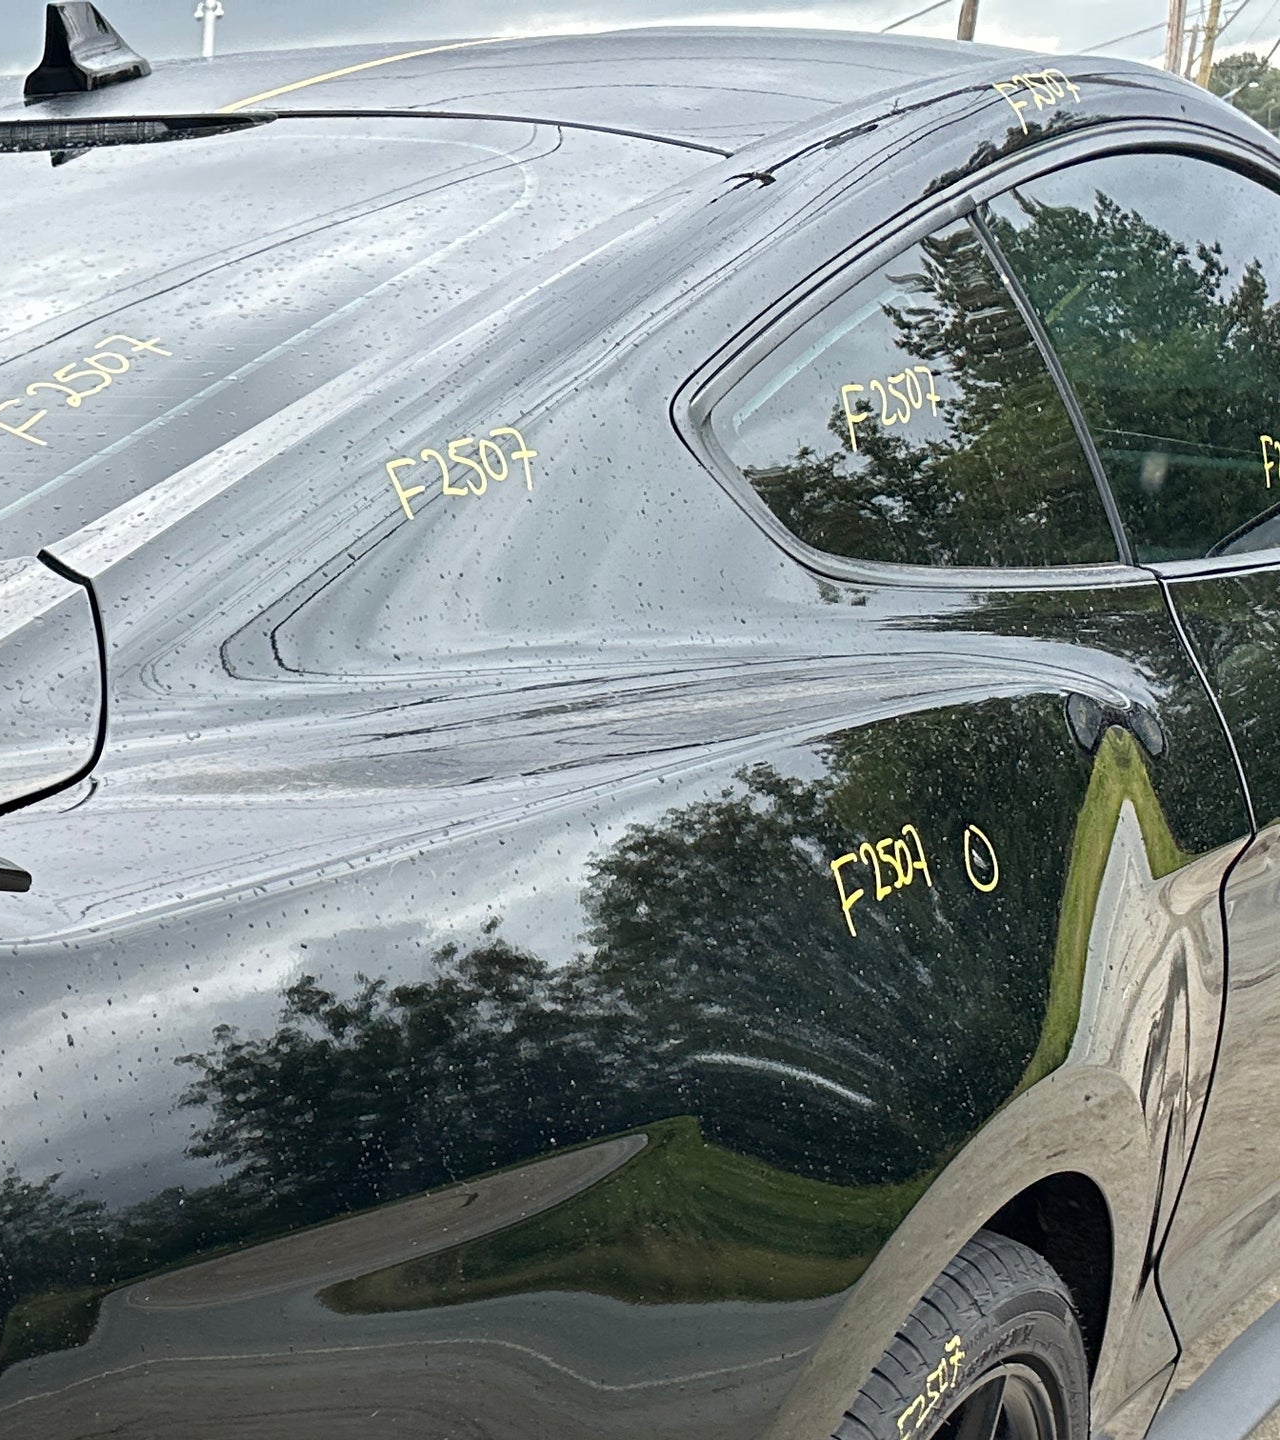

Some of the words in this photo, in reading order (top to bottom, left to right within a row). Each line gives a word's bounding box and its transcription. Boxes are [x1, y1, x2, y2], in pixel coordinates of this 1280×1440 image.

[992, 68, 1081, 136] F2507
[842, 366, 941, 452] F2507
[386, 427, 538, 520] F2507
[1260, 435, 1280, 488] F
[830, 823, 933, 937] F2507
